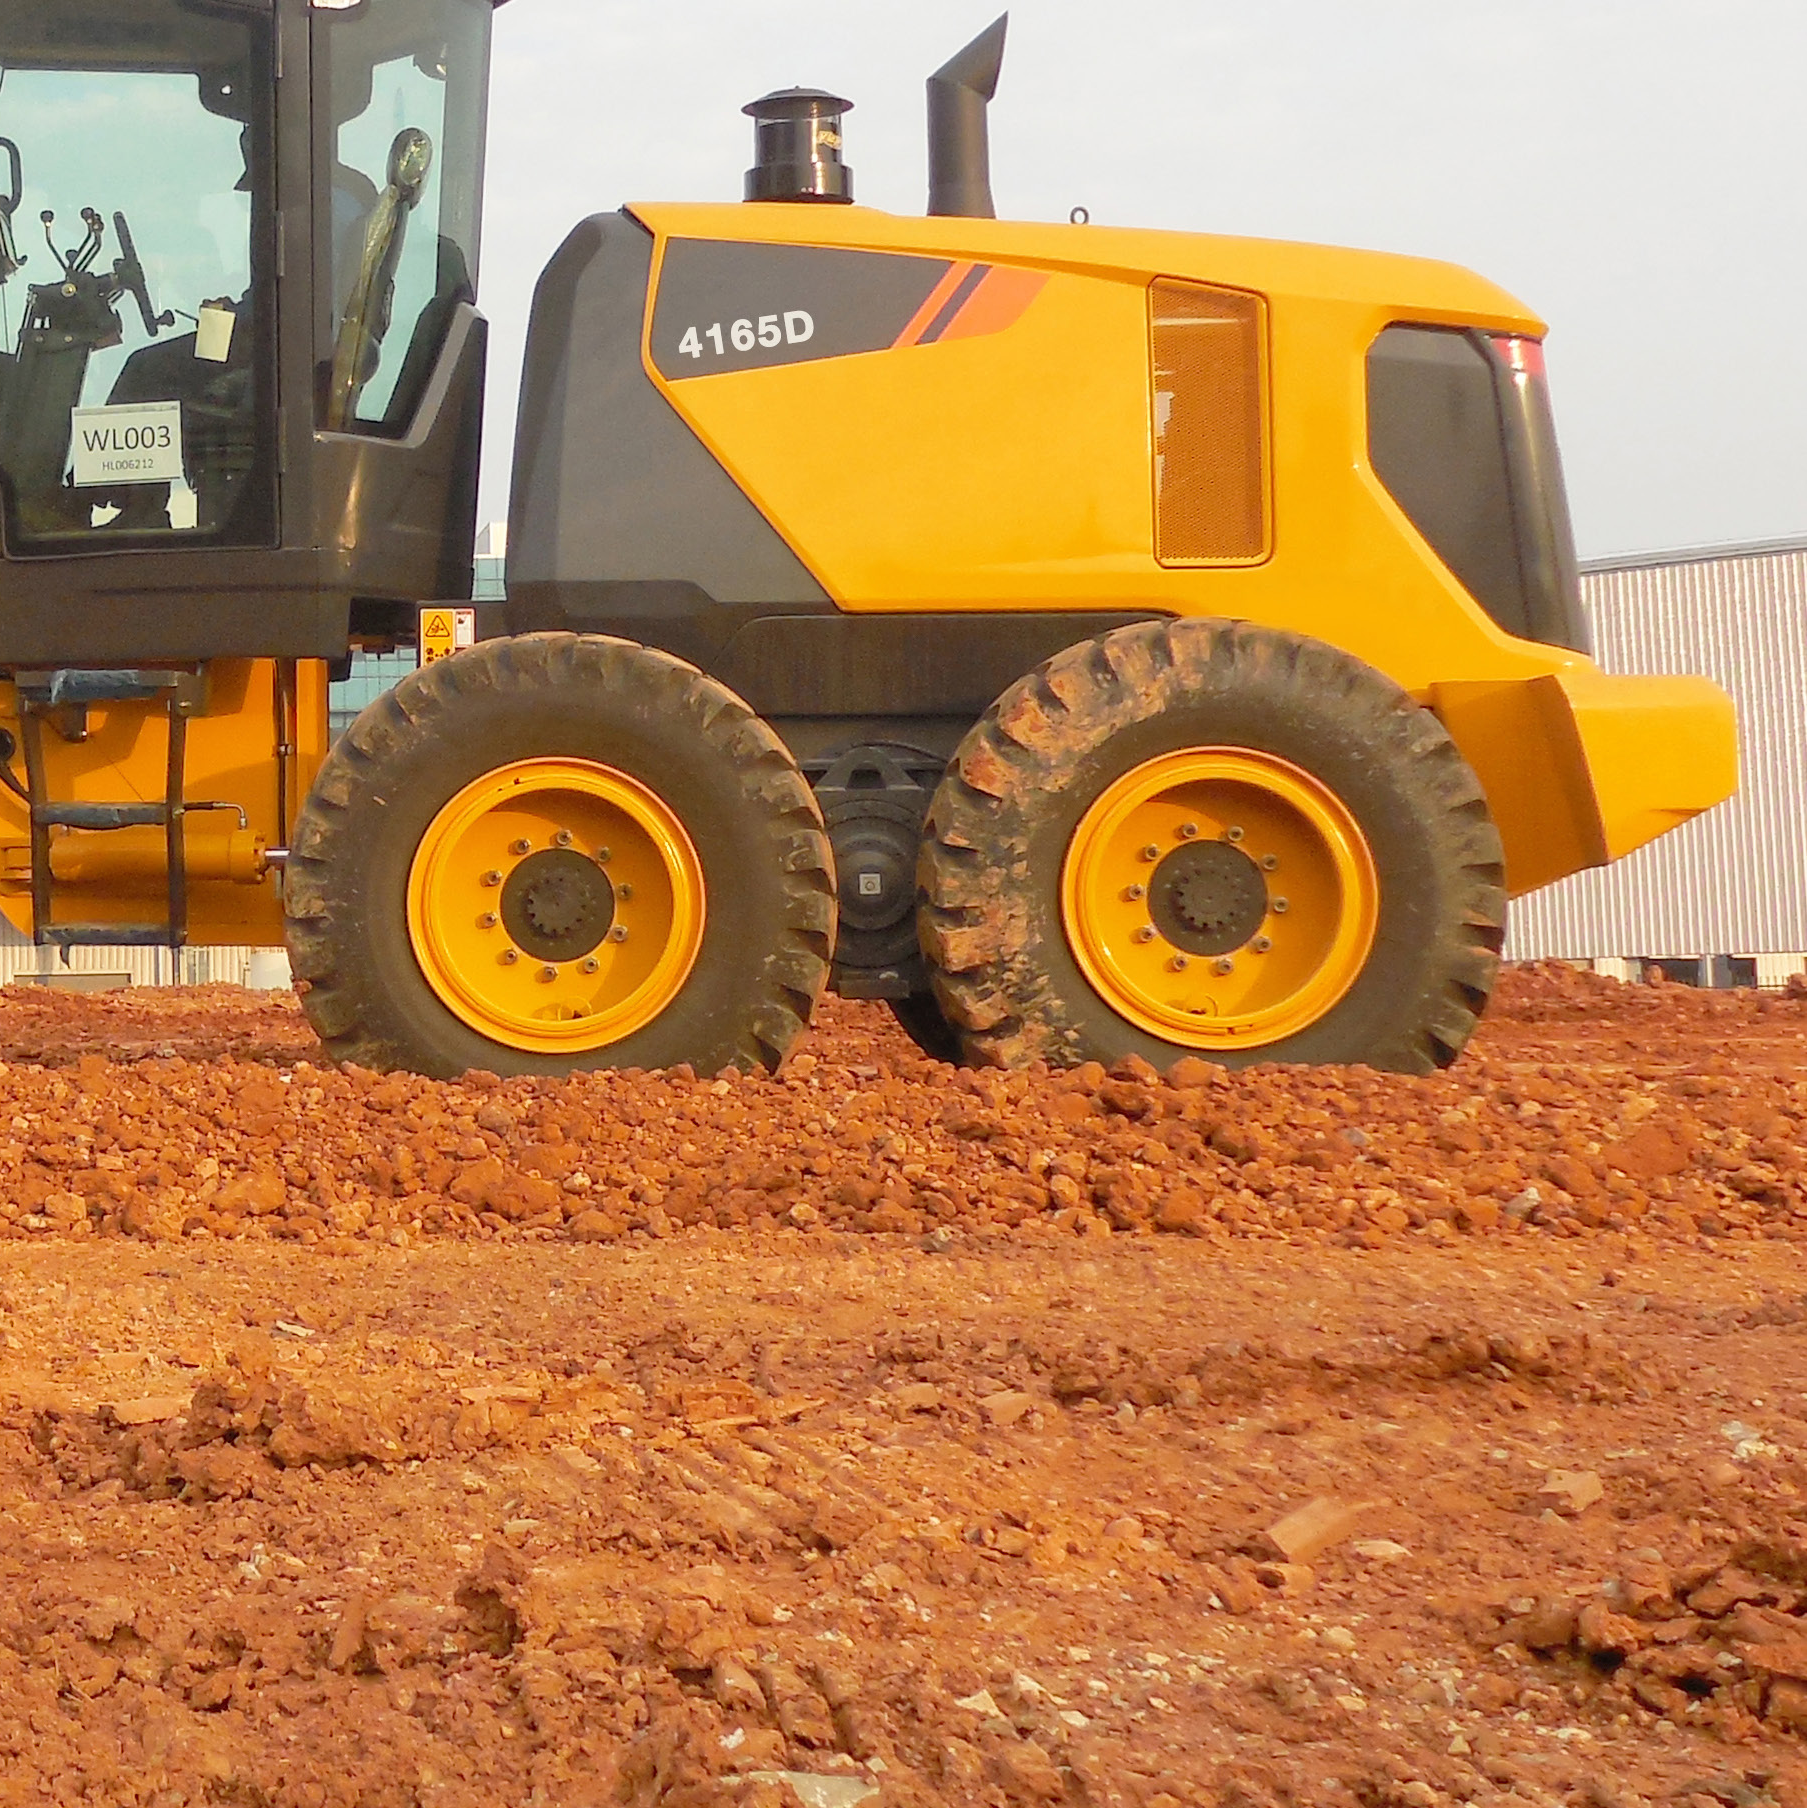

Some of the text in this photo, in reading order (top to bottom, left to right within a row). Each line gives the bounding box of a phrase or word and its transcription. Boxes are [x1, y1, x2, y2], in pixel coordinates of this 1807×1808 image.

[678, 310, 815, 359] 4165D
[83, 425, 171, 452] WL003
[102, 458, 154, 471] HL006212
